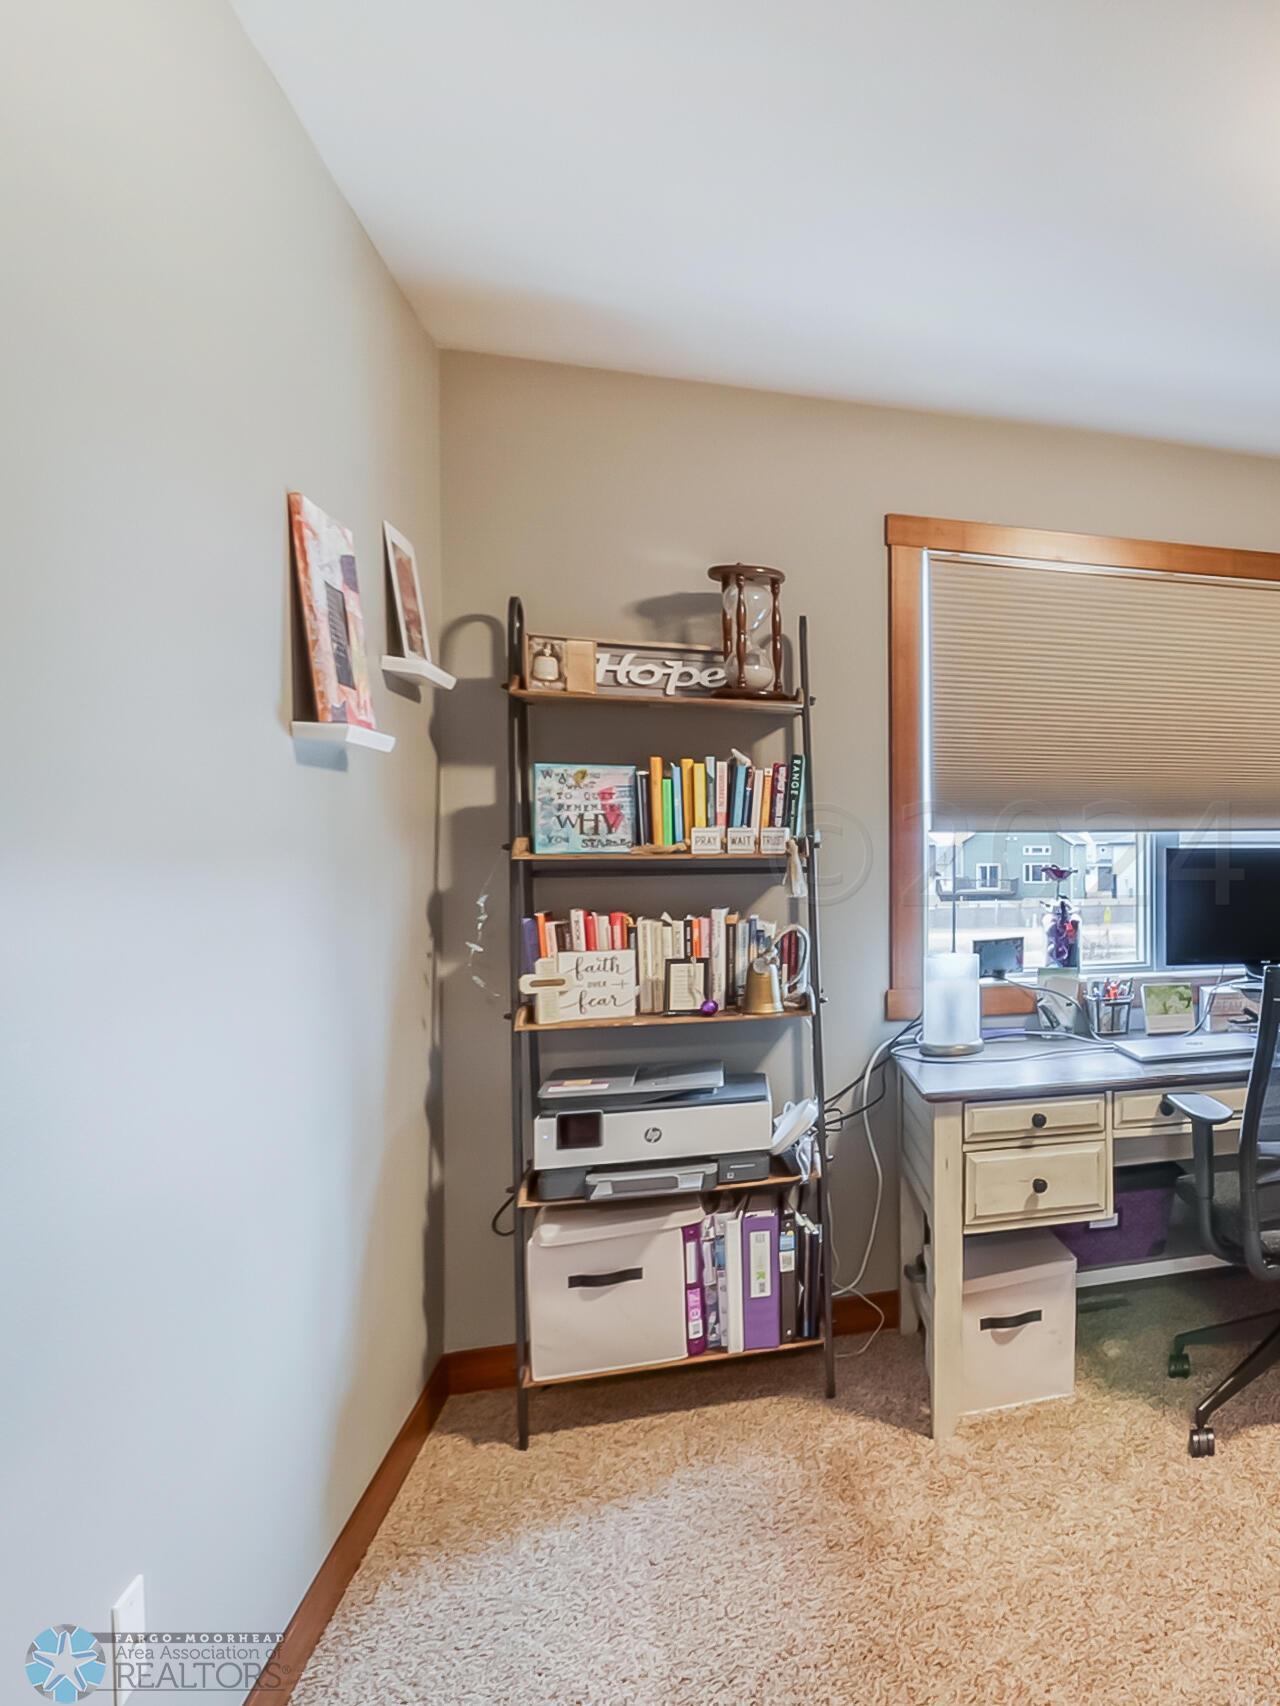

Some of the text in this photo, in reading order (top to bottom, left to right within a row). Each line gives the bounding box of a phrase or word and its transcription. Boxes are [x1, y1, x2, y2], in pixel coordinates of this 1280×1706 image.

[595, 653, 727, 695] Hope
[554, 813, 624, 835] WHY
[564, 955, 633, 981] faith
[562, 990, 633, 1015] fear
